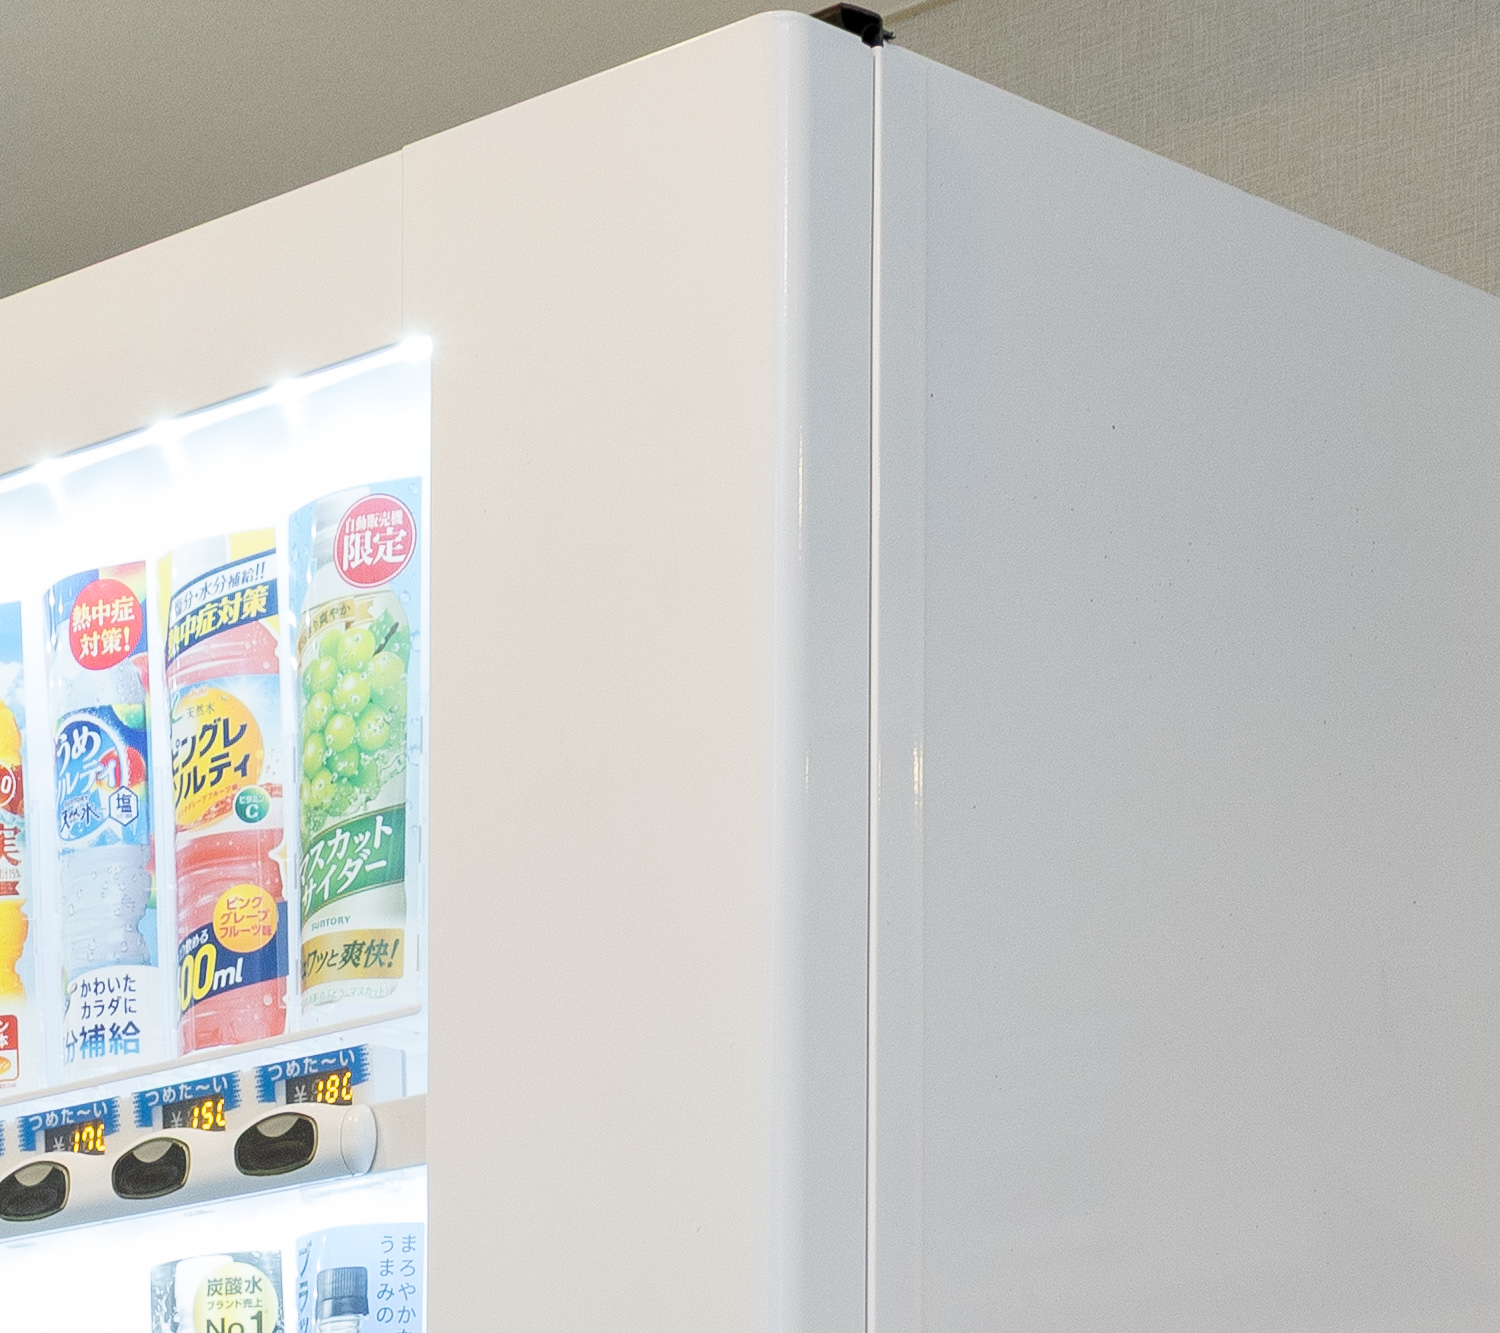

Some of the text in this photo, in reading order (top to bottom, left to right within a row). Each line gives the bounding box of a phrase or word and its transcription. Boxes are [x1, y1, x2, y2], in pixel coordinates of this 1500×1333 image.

[345, 509, 404, 532] 自動販売機
[342, 527, 407, 572] 限定
[72, 596, 136, 632] 熱中症
[79, 626, 131, 659] 対策!
[116, 793, 132, 812] 塩
[245, 804, 259, 819] C
[226, 896, 263, 910] ピンク
[220, 909, 270, 925] グレープ
[219, 923, 272, 938] フルーツ味
[81, 974, 137, 998] かわいた
[81, 996, 137, 1020] カラダに
[207, 1275, 262, 1297] 炭酸水
[376, 1235, 395, 1324] うまみの
[207, 1298, 263, 1311] ブランド売上
